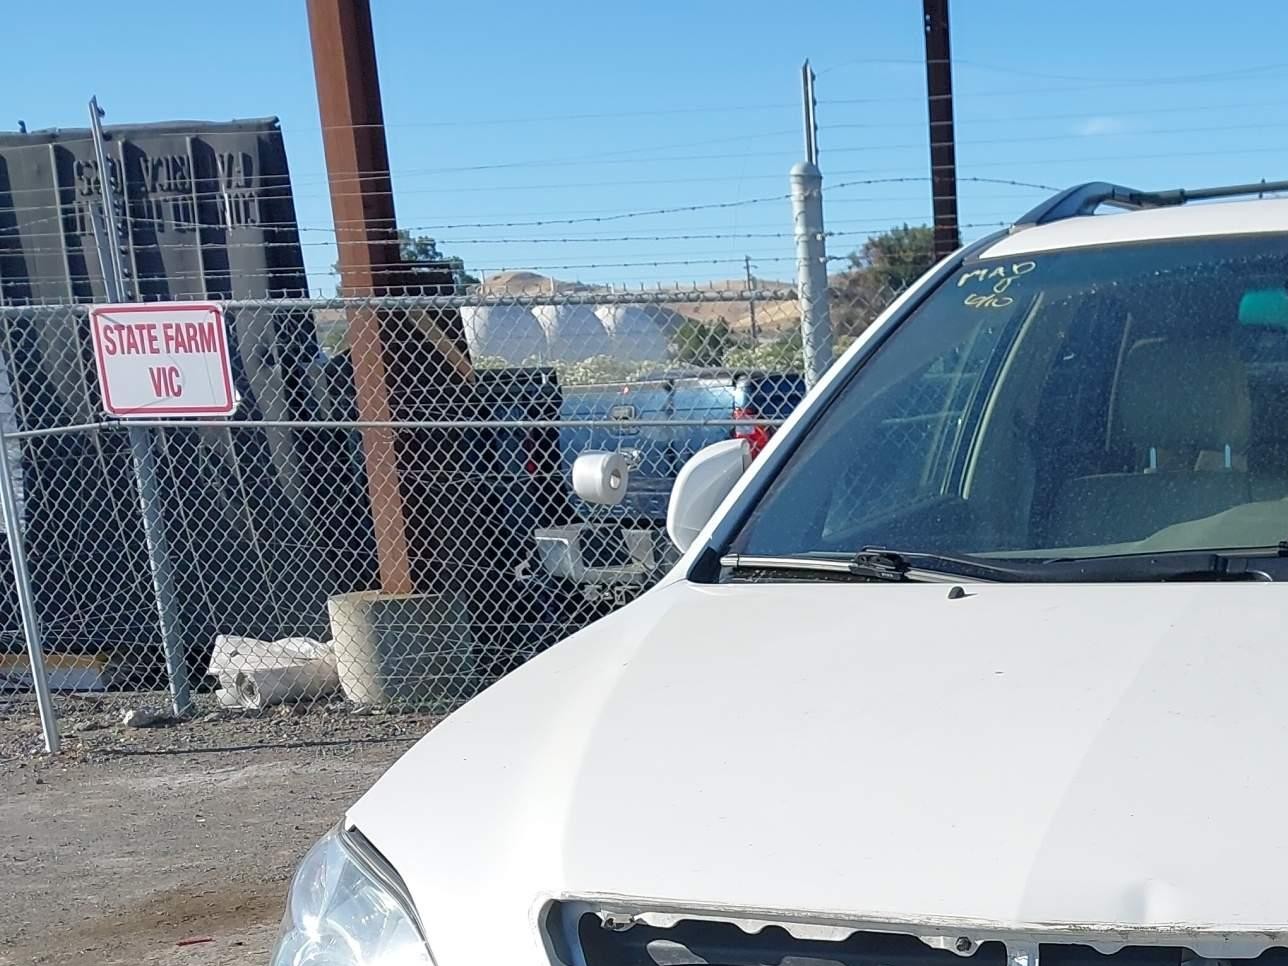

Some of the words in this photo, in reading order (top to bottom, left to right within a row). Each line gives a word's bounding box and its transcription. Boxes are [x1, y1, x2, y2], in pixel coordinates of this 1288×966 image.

[103, 323, 160, 355] STATE
[162, 321, 217, 354] FARM
[149, 366, 182, 397] VIC
